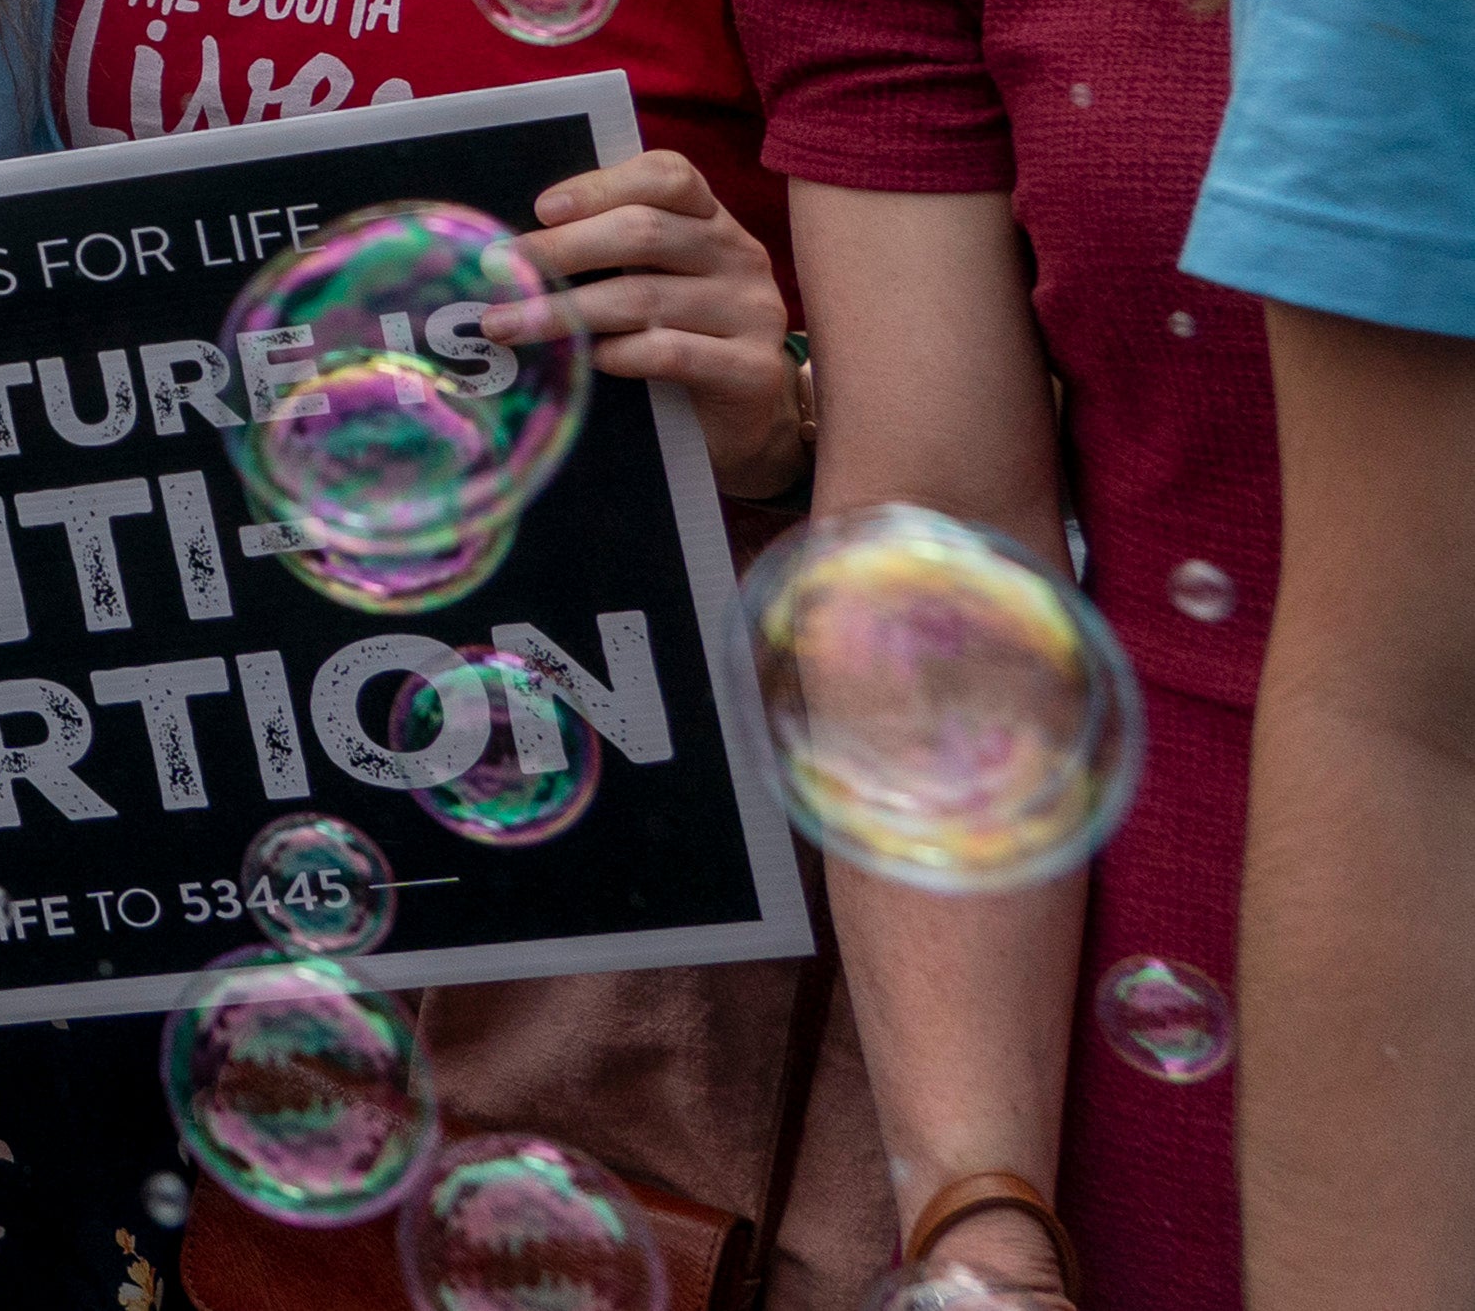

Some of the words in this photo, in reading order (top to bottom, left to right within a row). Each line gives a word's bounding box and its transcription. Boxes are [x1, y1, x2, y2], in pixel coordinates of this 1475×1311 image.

[37, 225, 175, 287] FOR
[194, 203, 323, 269] LIFE
[85, 886, 160, 934] TO
[177, 867, 352, 926] 53445
